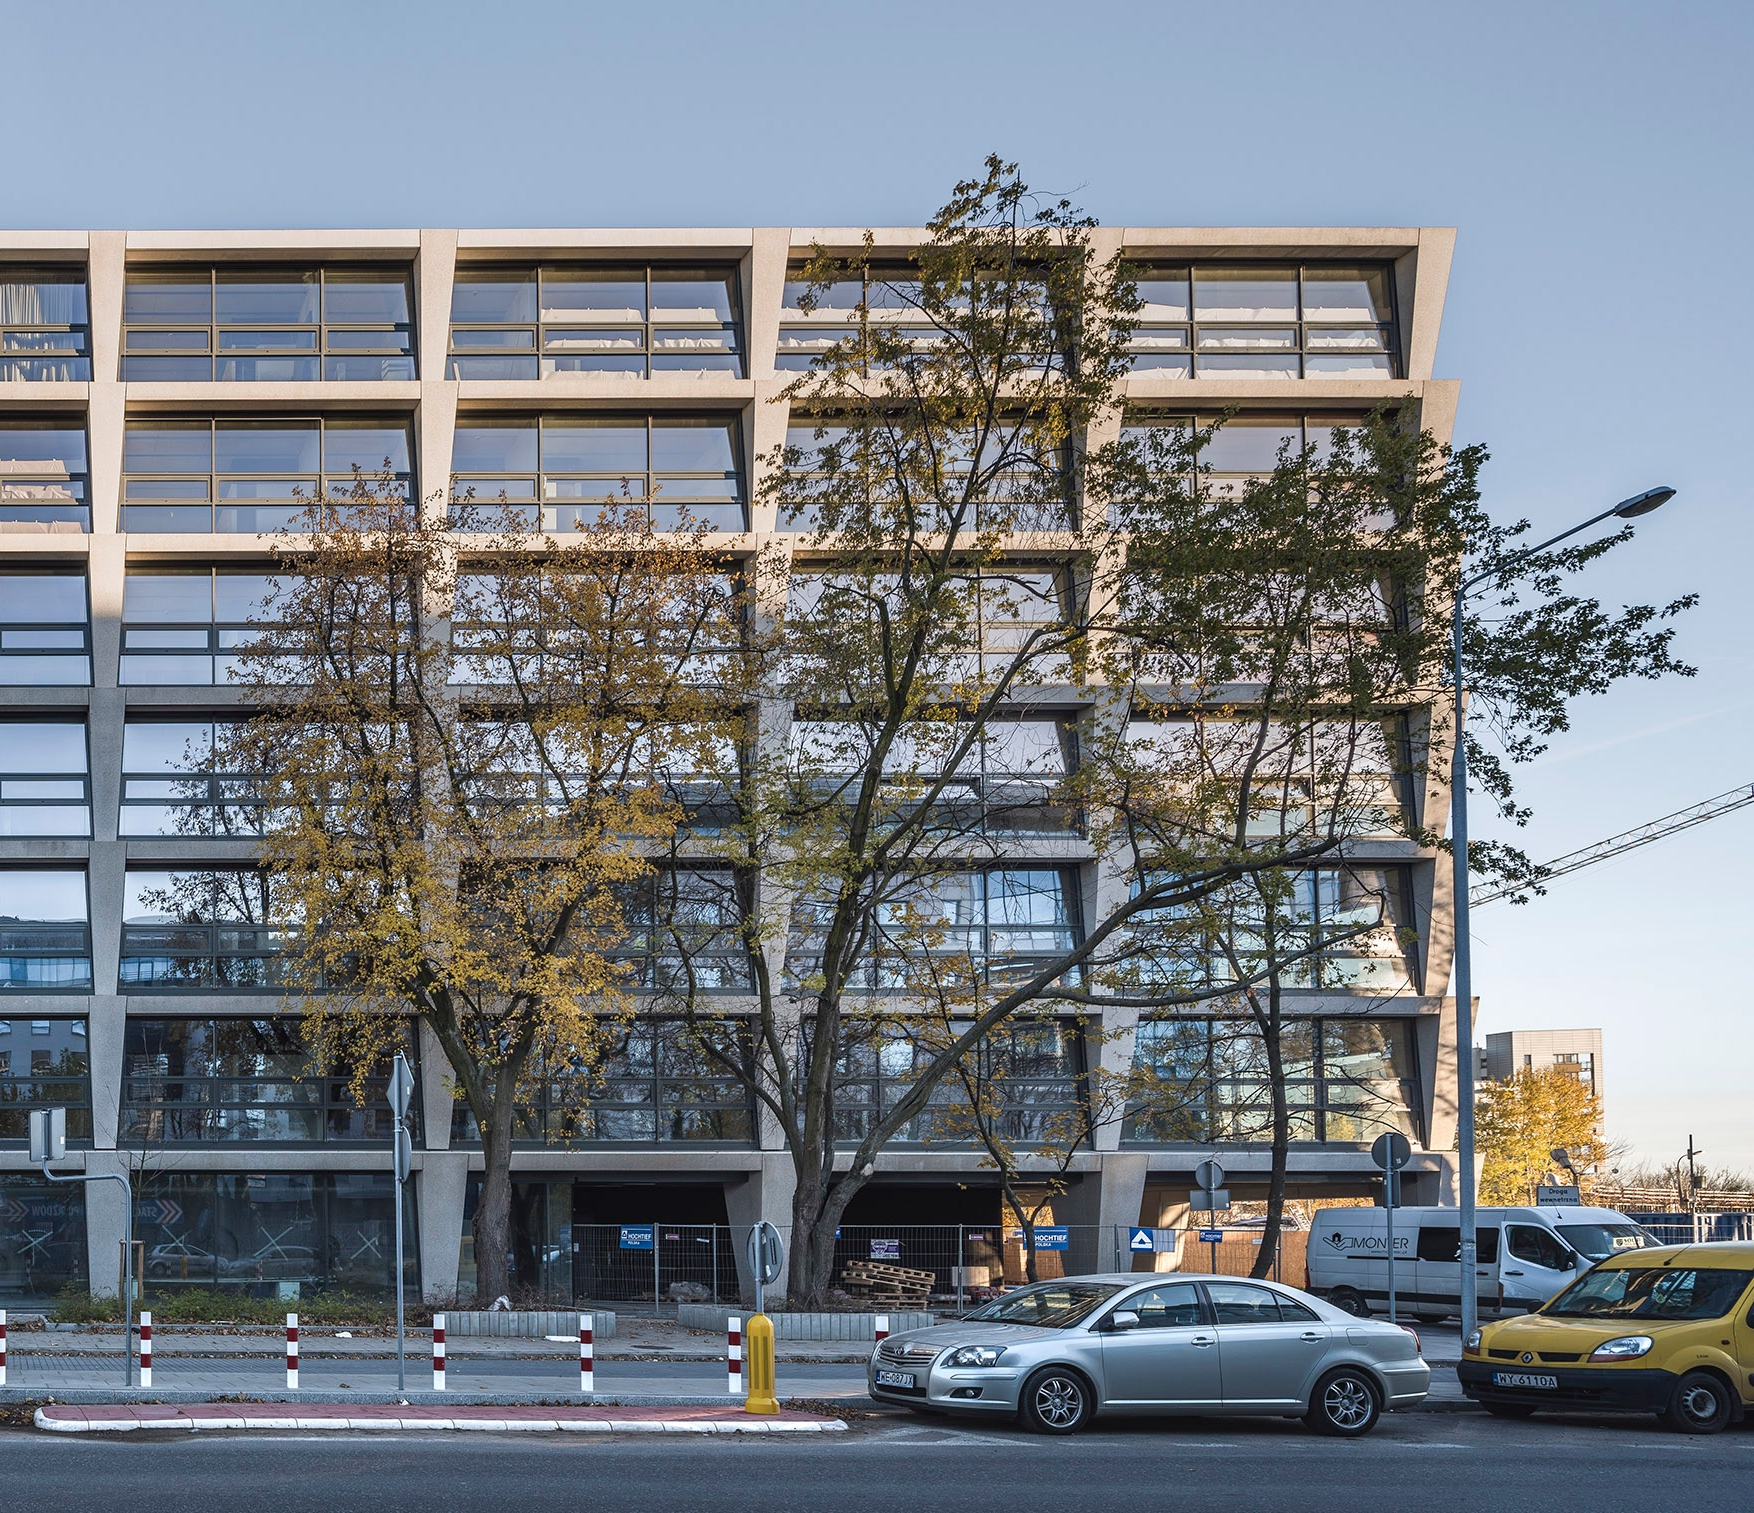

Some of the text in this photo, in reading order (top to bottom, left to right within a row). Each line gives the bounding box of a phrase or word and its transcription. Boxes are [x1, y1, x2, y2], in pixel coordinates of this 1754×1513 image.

[1353, 1237, 1409, 1249] MONER
[1498, 1373, 1556, 1387] WY 6110A
